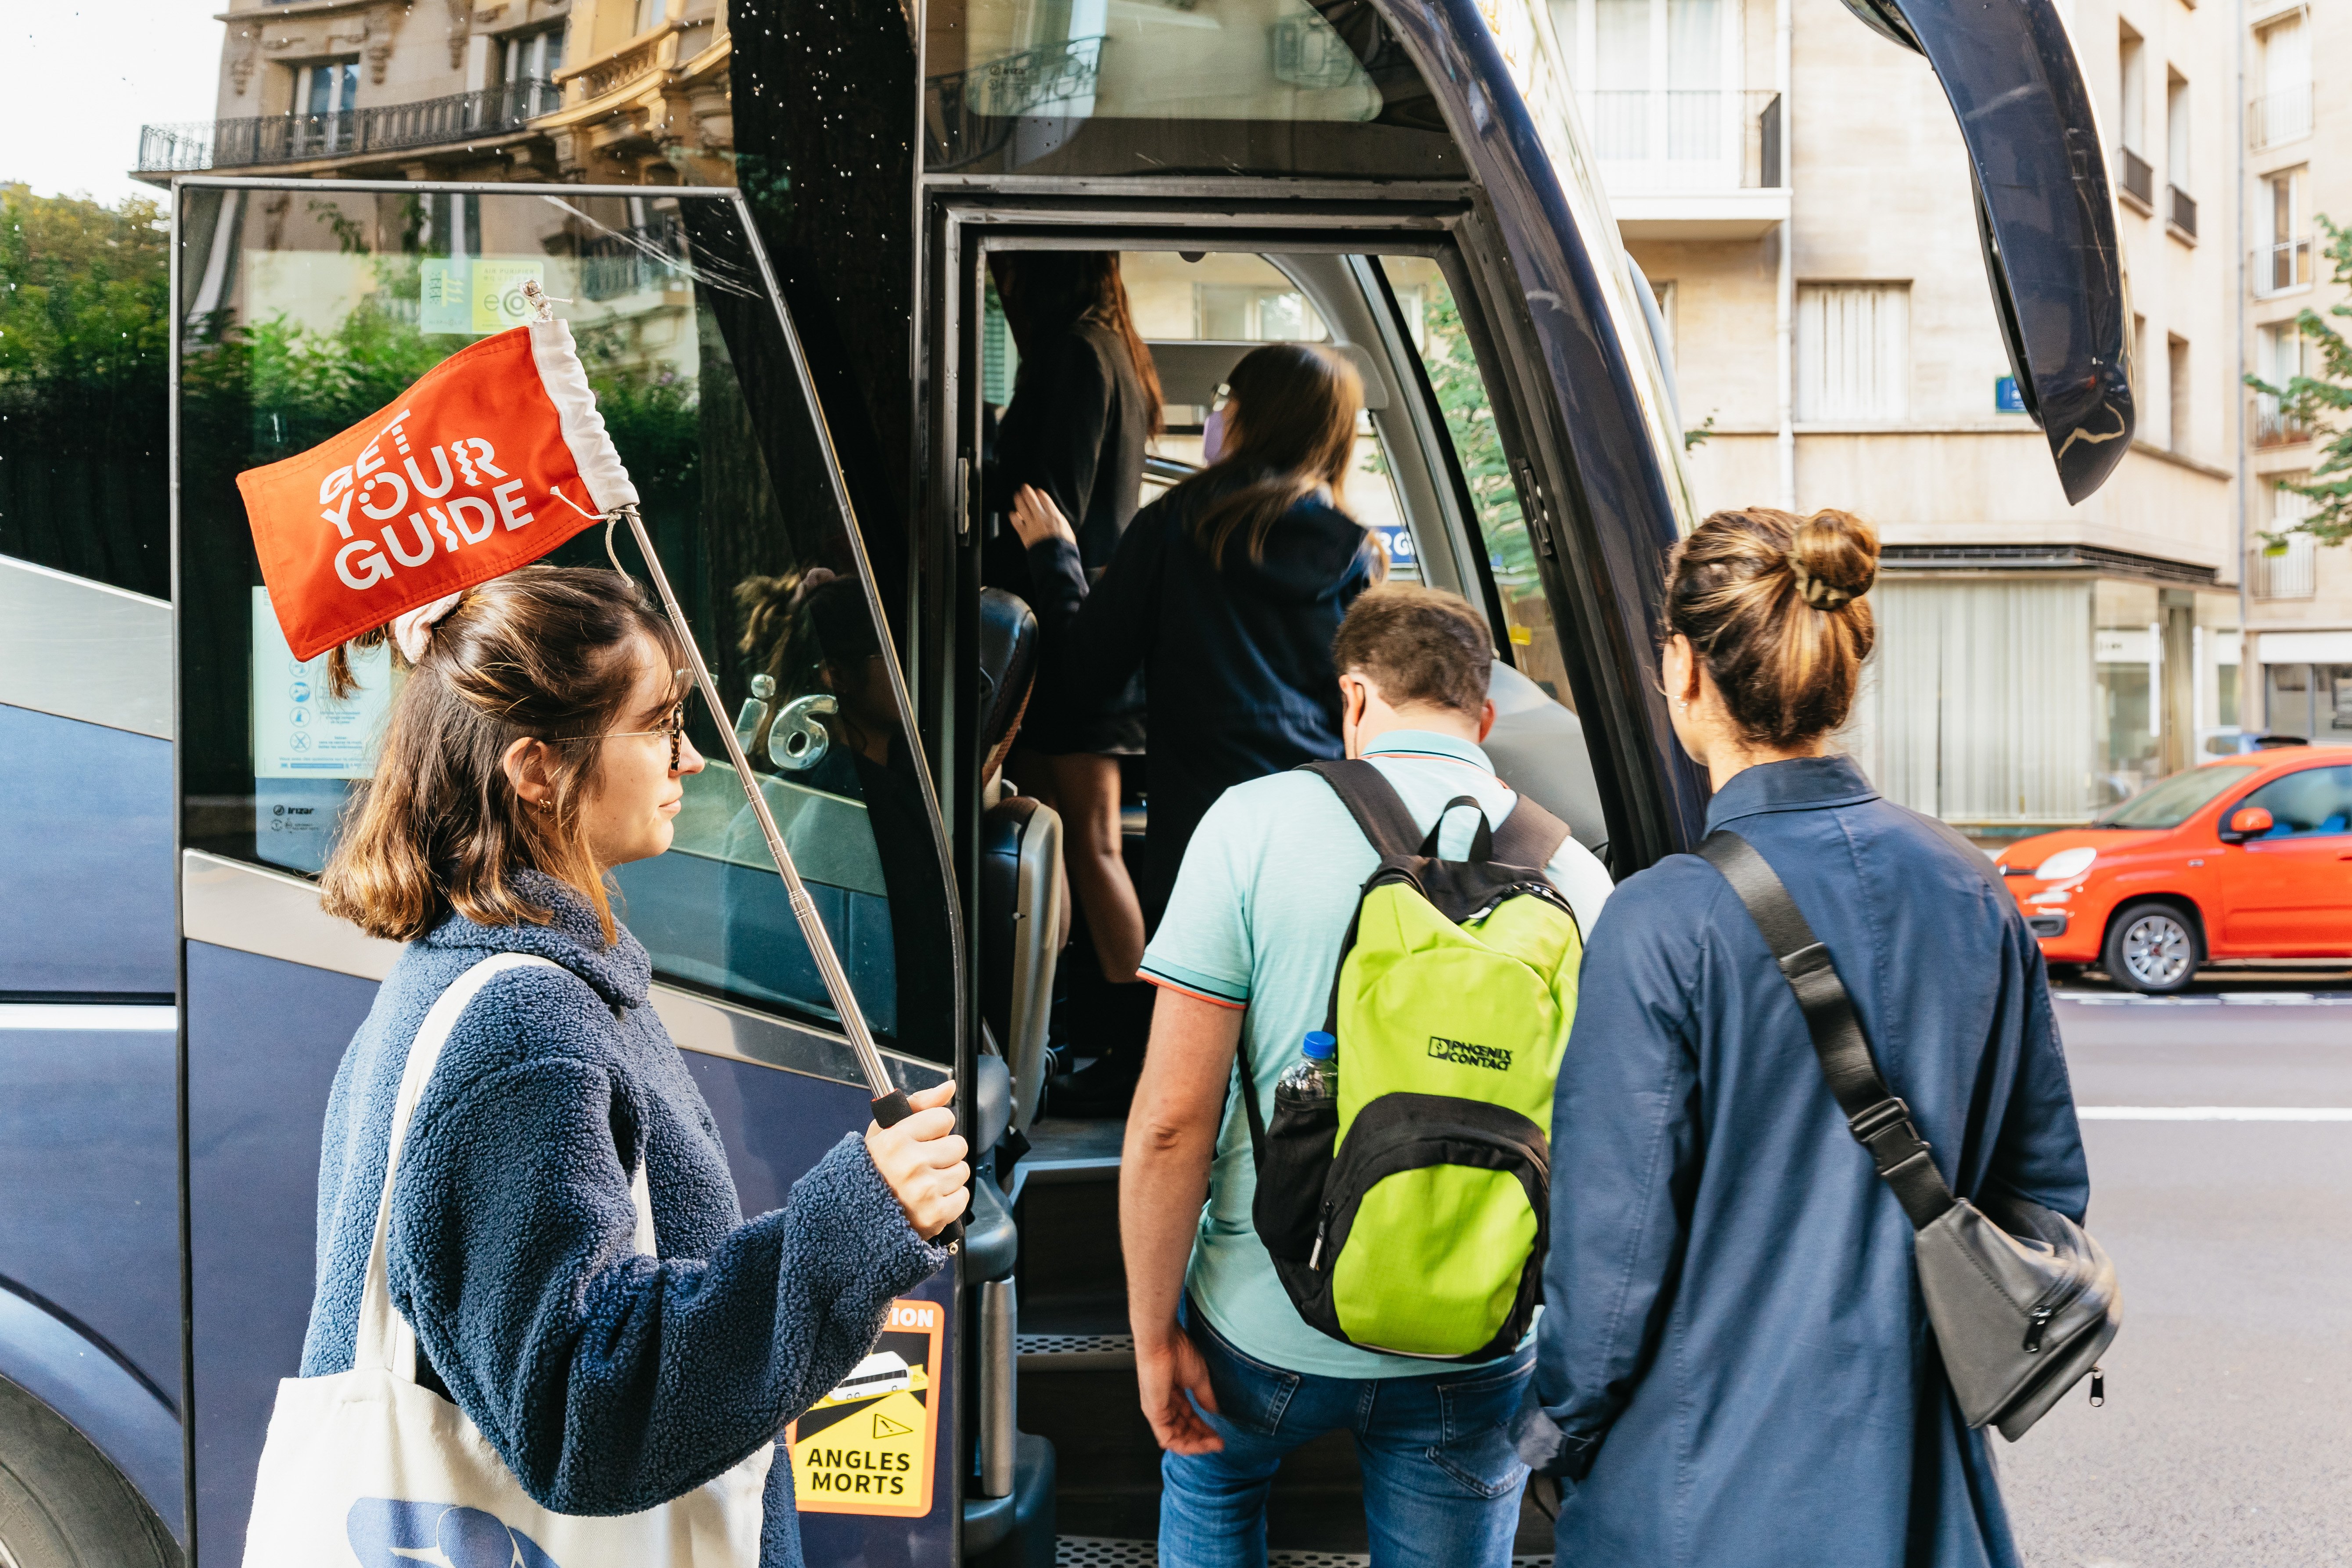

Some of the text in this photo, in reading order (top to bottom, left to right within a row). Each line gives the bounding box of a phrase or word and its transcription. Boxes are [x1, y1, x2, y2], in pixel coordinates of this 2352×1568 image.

[320, 409, 411, 504] GET
[320, 437, 509, 539] YOUR
[334, 478, 535, 590] GUIDE
[734, 673, 839, 771] i6
[1449, 1052, 1511, 1071] CONTACT
[807, 1448, 910, 1471] ANGLES
[812, 1472, 903, 1494] MORTS
